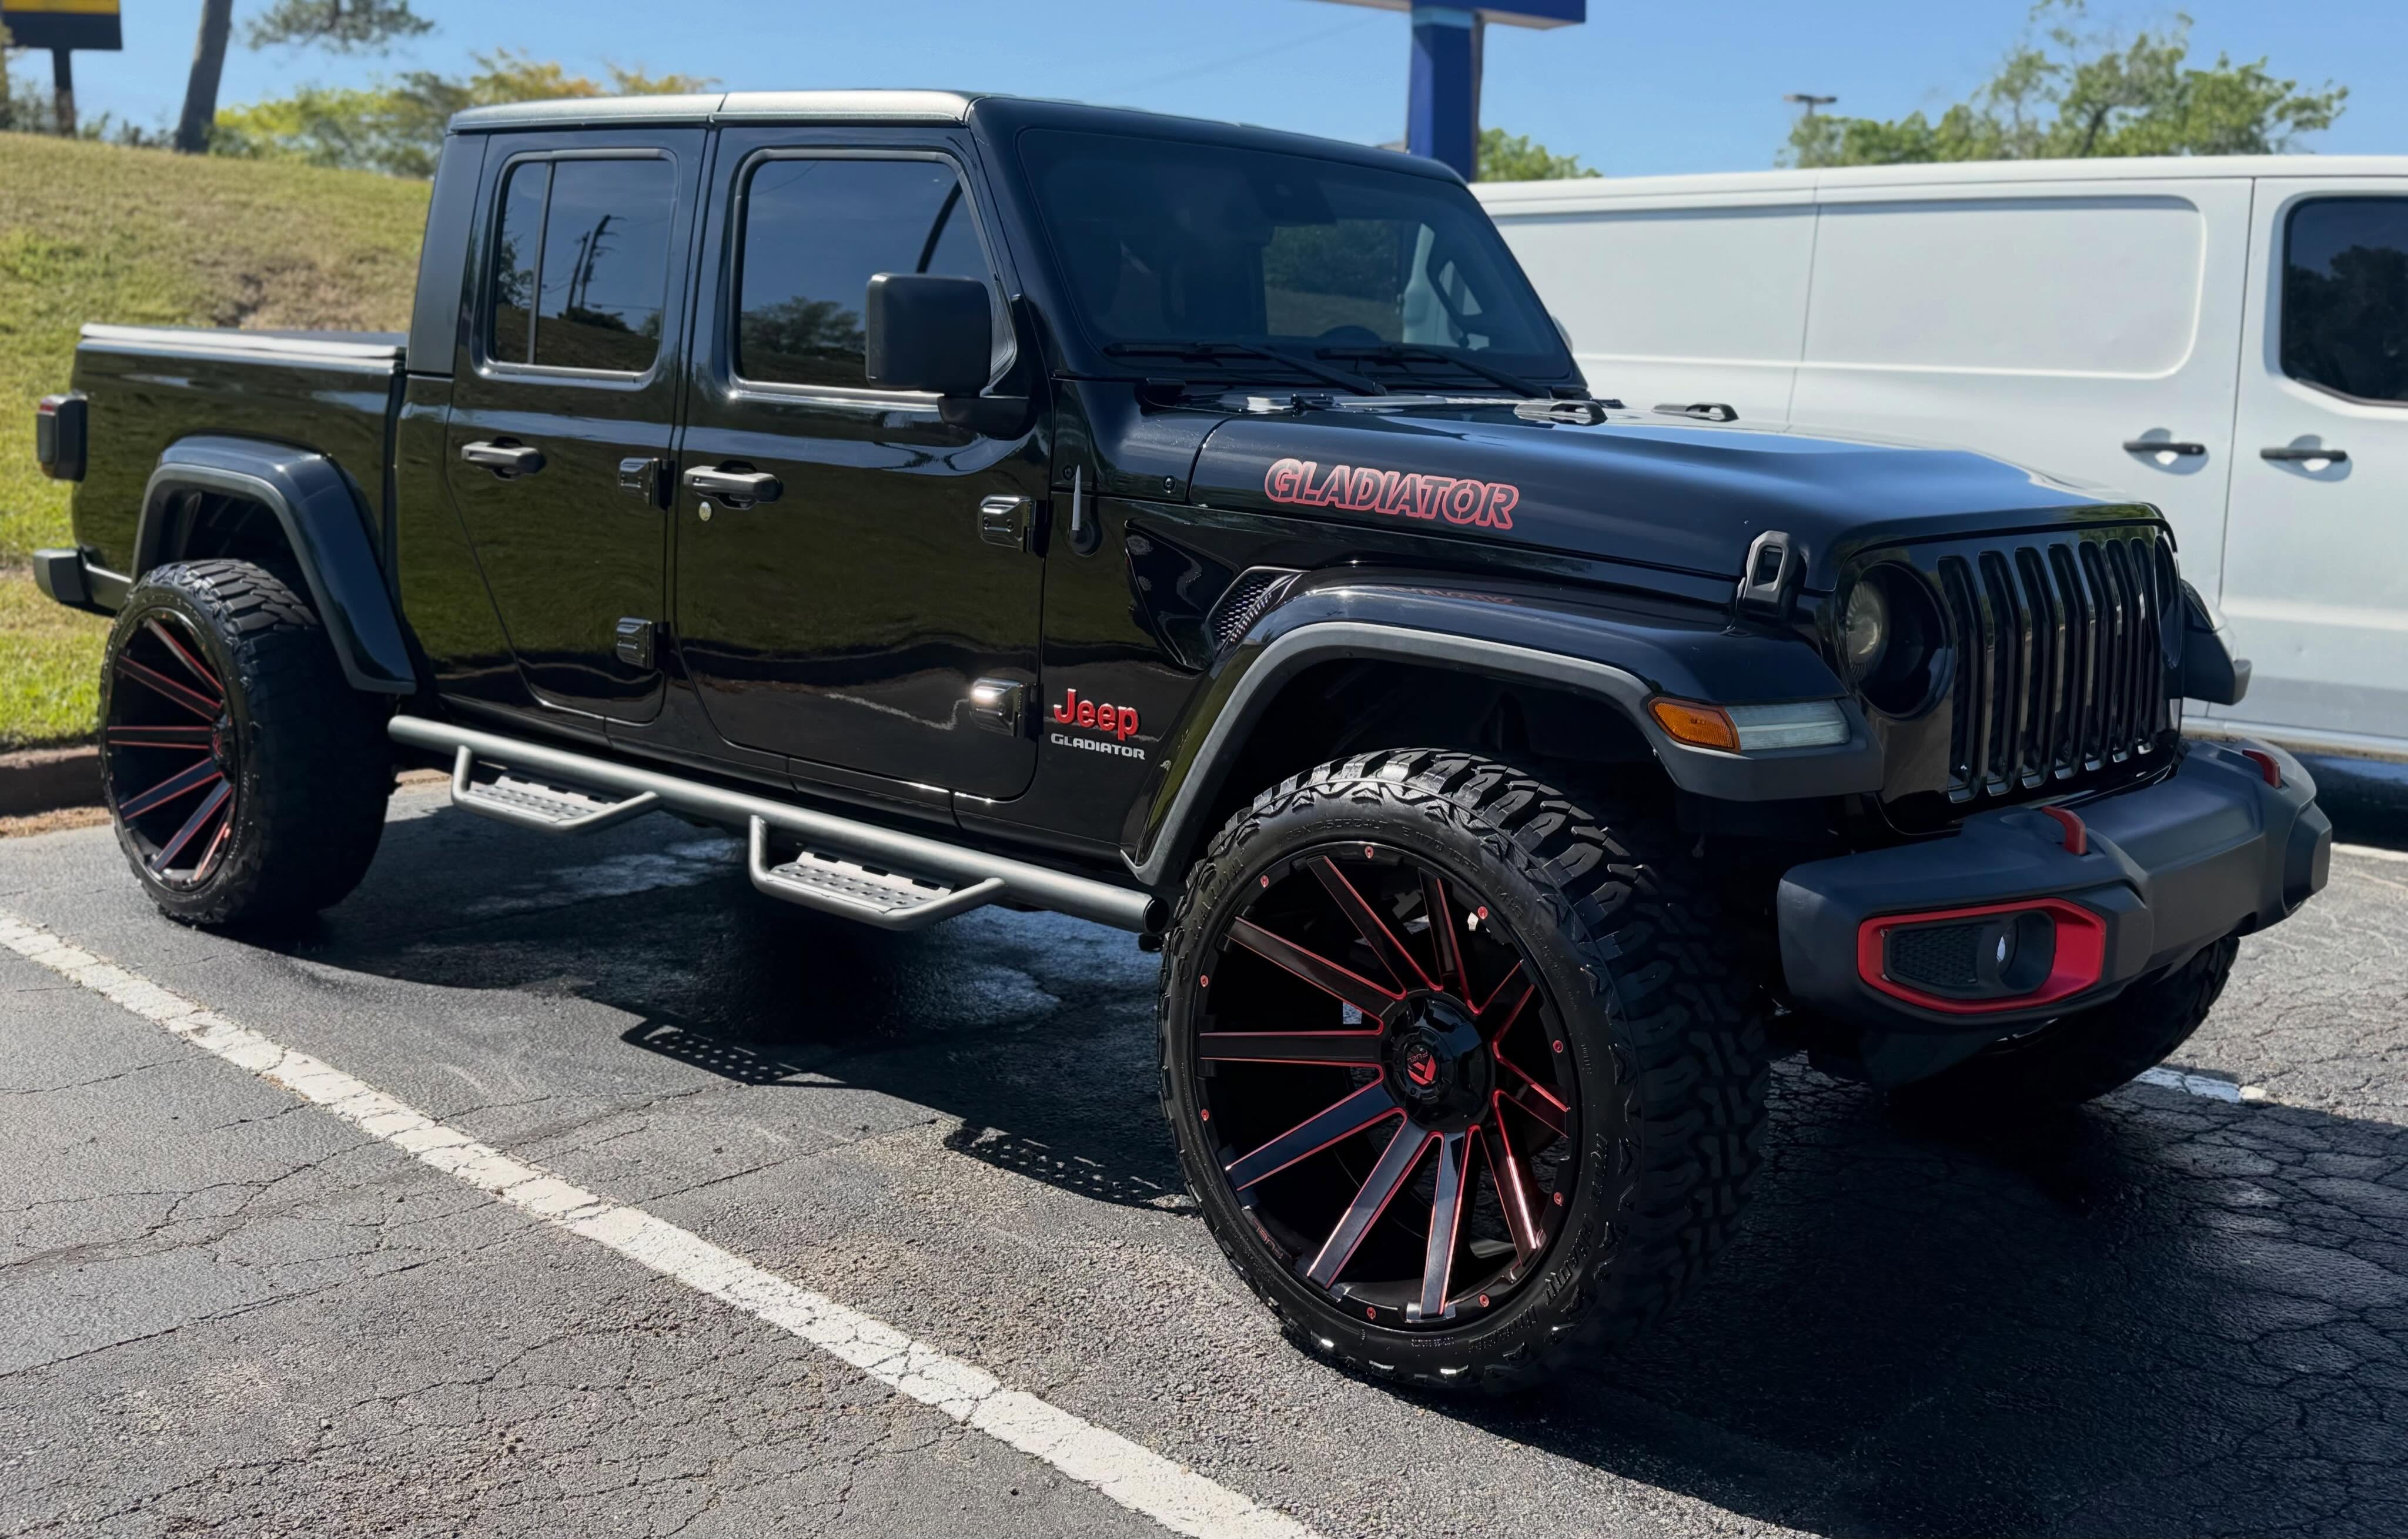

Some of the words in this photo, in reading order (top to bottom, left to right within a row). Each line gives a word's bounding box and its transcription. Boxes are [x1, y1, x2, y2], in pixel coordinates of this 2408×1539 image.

[1265, 458, 1519, 529] GLADIATOR
[1054, 688, 1139, 741] Jeep
[1051, 733, 1145, 760] GLADIATOR
